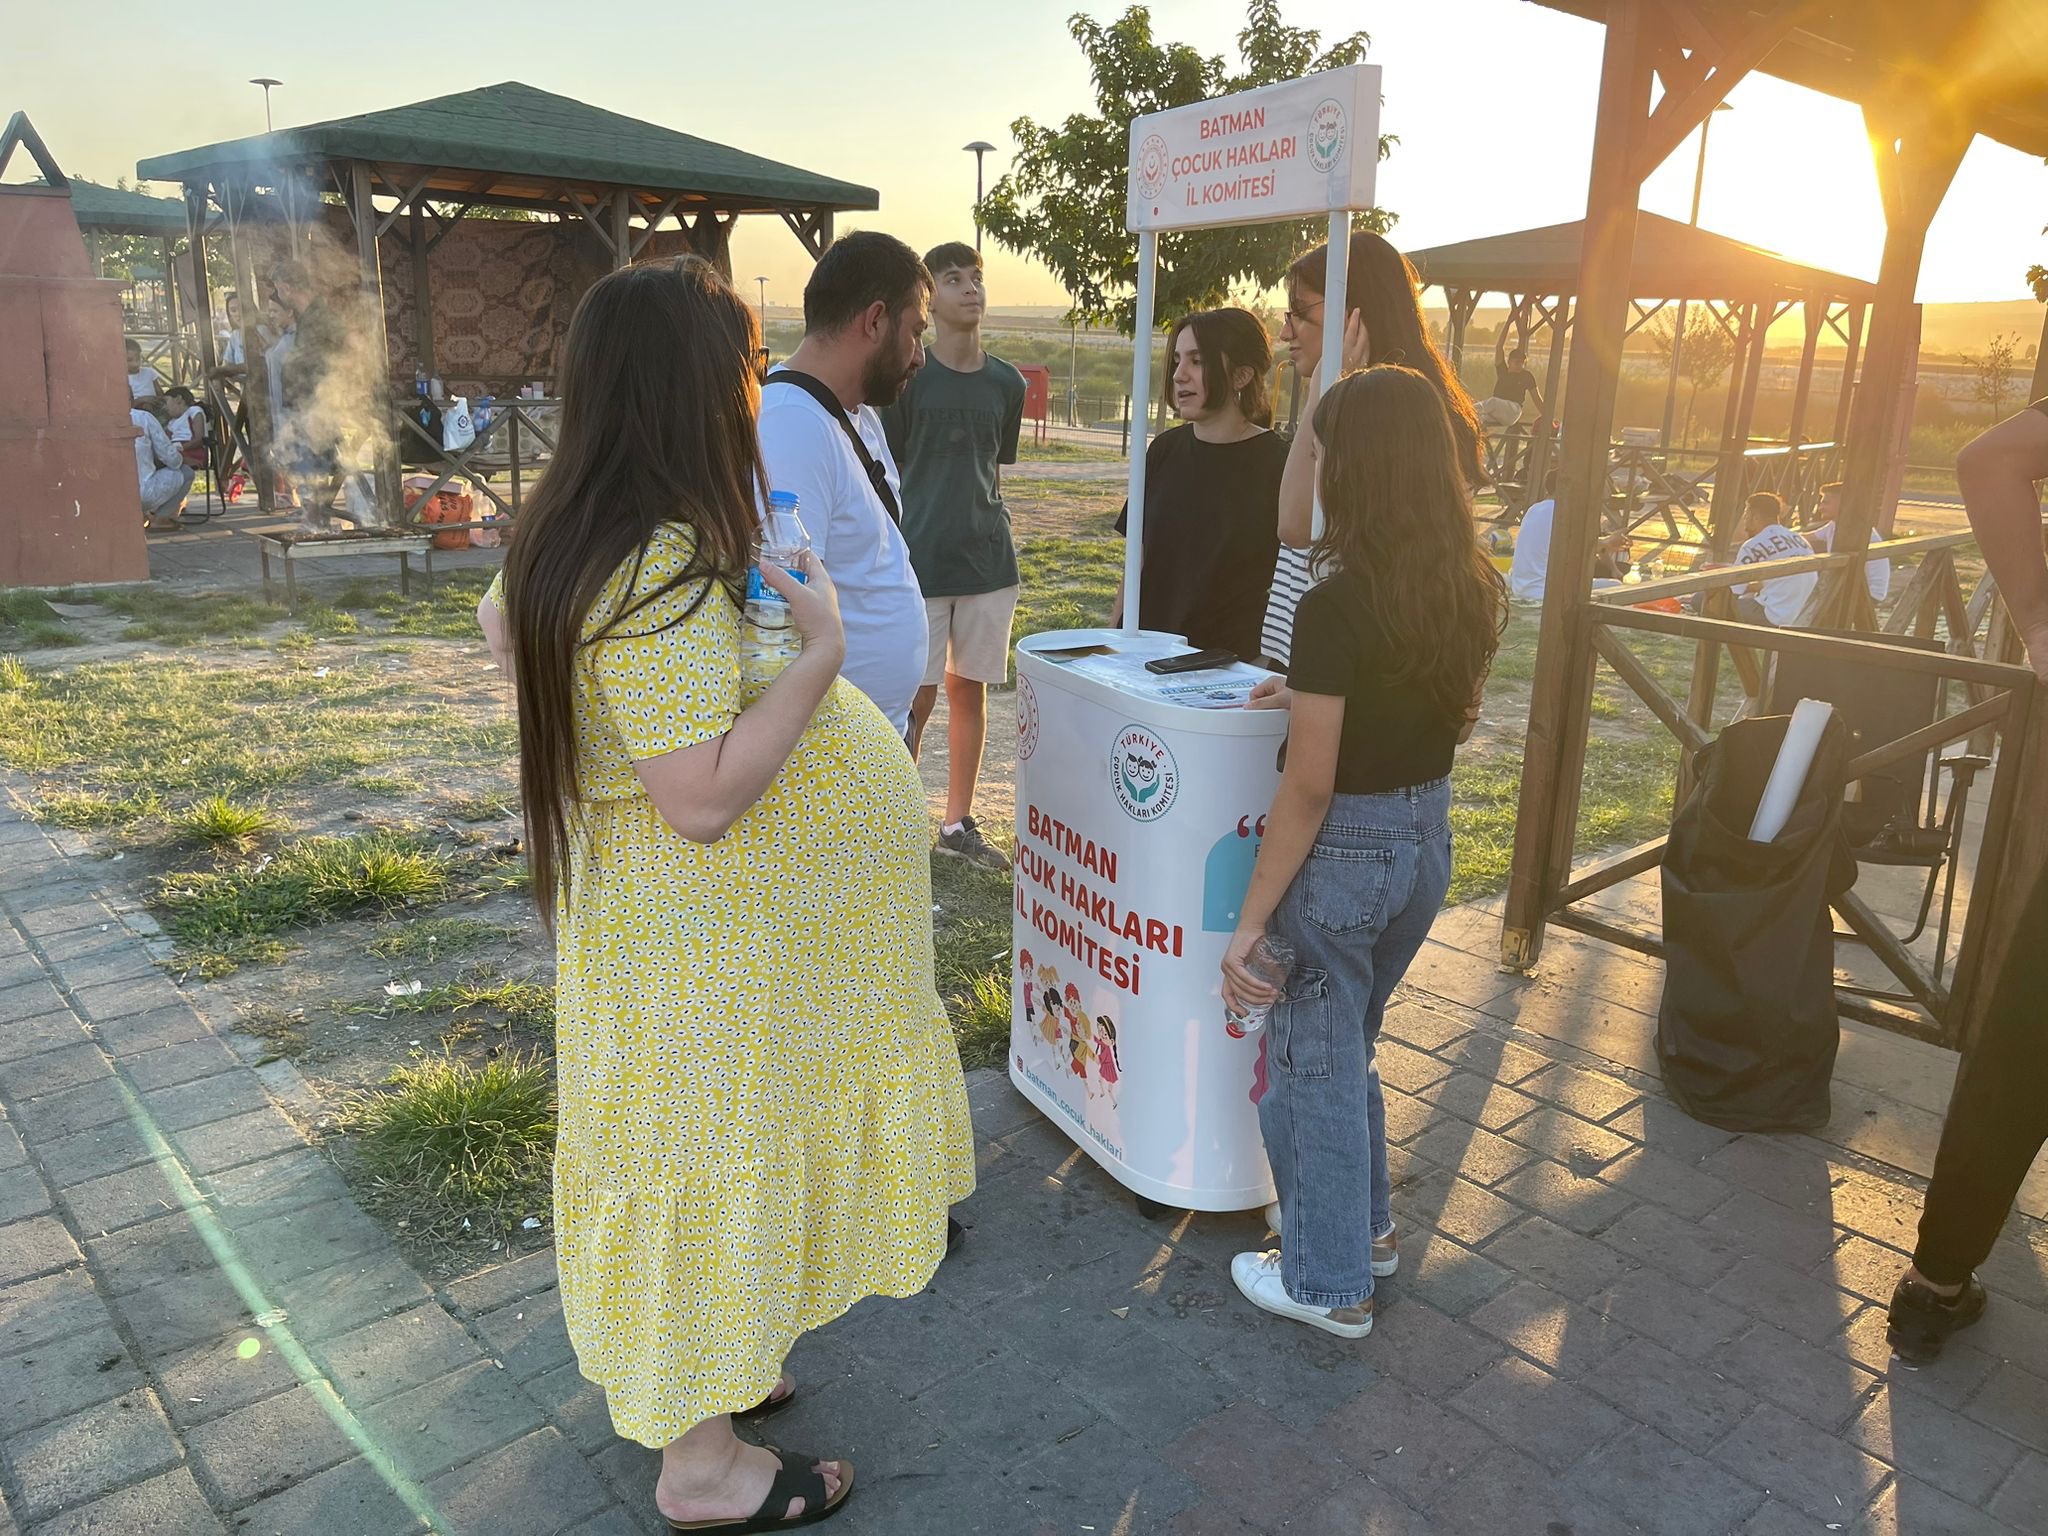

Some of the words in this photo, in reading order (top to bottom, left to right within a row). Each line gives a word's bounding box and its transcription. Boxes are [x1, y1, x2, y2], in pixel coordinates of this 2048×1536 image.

[1200, 106, 1265, 139] BATMAN
[1171, 149, 1222, 183] ÇOCUK
[1226, 136, 1296, 169] HAKLARI
[1186, 182, 1199, 207] İL
[1202, 168, 1275, 204] KOMİTESİ
[1120, 732, 1165, 760] TÜRKİYE
[1113, 755, 1123, 793] ÇOCUK
[1119, 793, 1151, 818] HAKLARI
[1150, 772, 1174, 816] KOMİTESİ
[1028, 804, 1117, 884] BATMAN
[1016, 874, 1028, 920] İL
[1031, 898, 1140, 996] KOMİTESİ
[1060, 871, 1183, 958] HAKLARI
[1026, 1066, 1123, 1161] batman_cocuk_haklari
